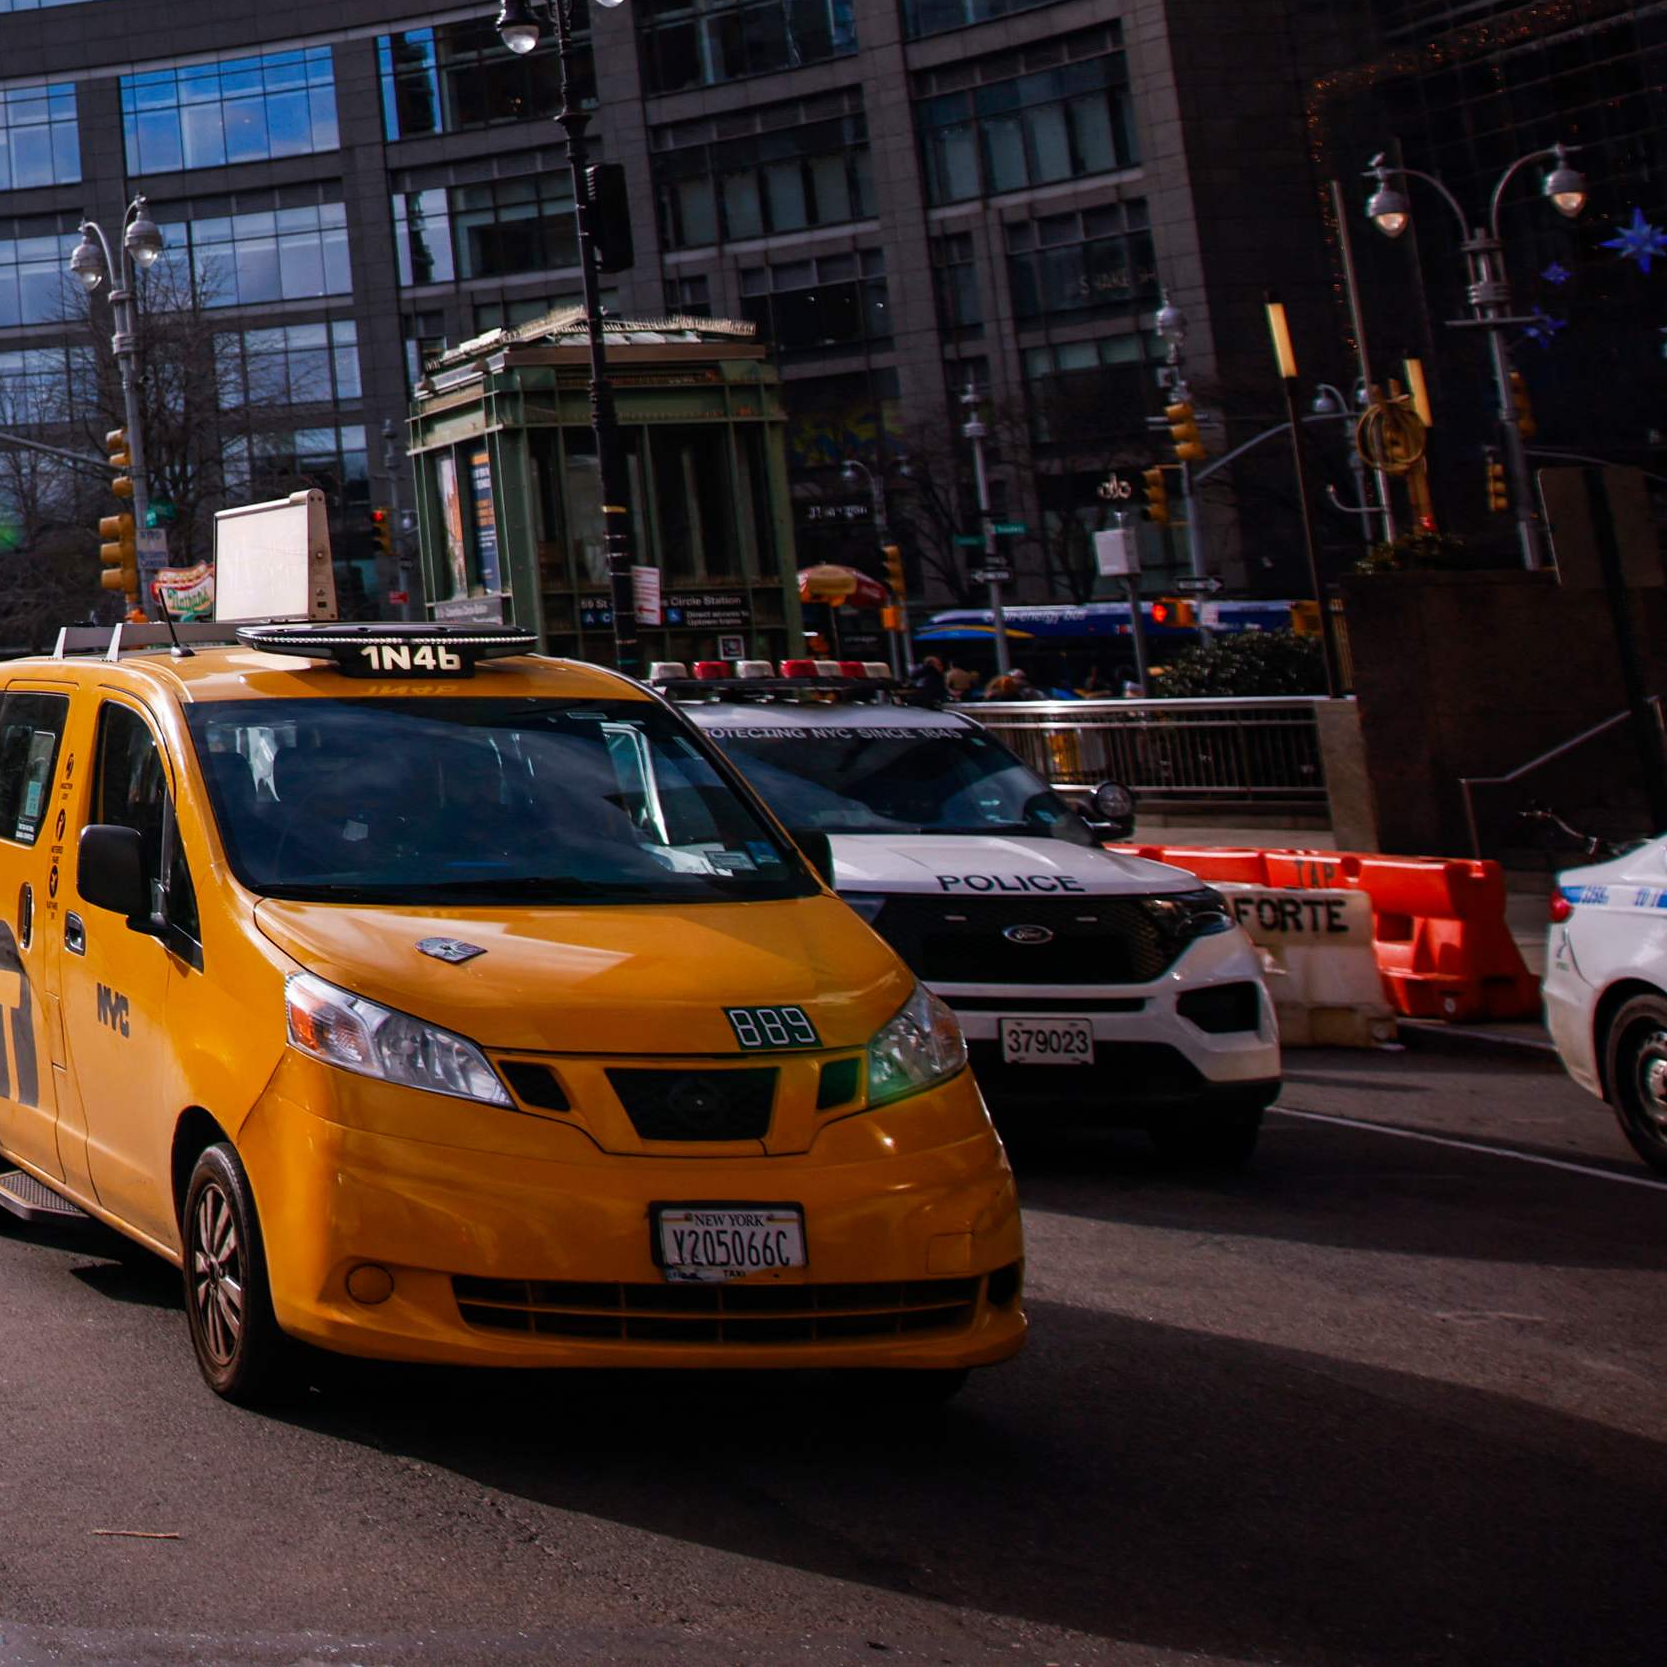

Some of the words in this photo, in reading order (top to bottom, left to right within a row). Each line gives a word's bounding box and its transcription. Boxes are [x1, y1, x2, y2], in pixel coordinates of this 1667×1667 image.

[670, 596, 701, 606] Circle
[703, 595, 741, 606] Station
[699, 727, 807, 739] ROTECTING
[811, 727, 853, 740] NYC
[859, 727, 917, 740] SINCE
[935, 875, 1086, 892] POLICE
[97, 982, 130, 1039] NYC
[729, 1007, 816, 1047] 889
[1009, 1030, 1088, 1053] 379023
[694, 1213, 725, 1227] NEW
[728, 1213, 765, 1228] YORK
[673, 1229, 791, 1267] Y205066C
